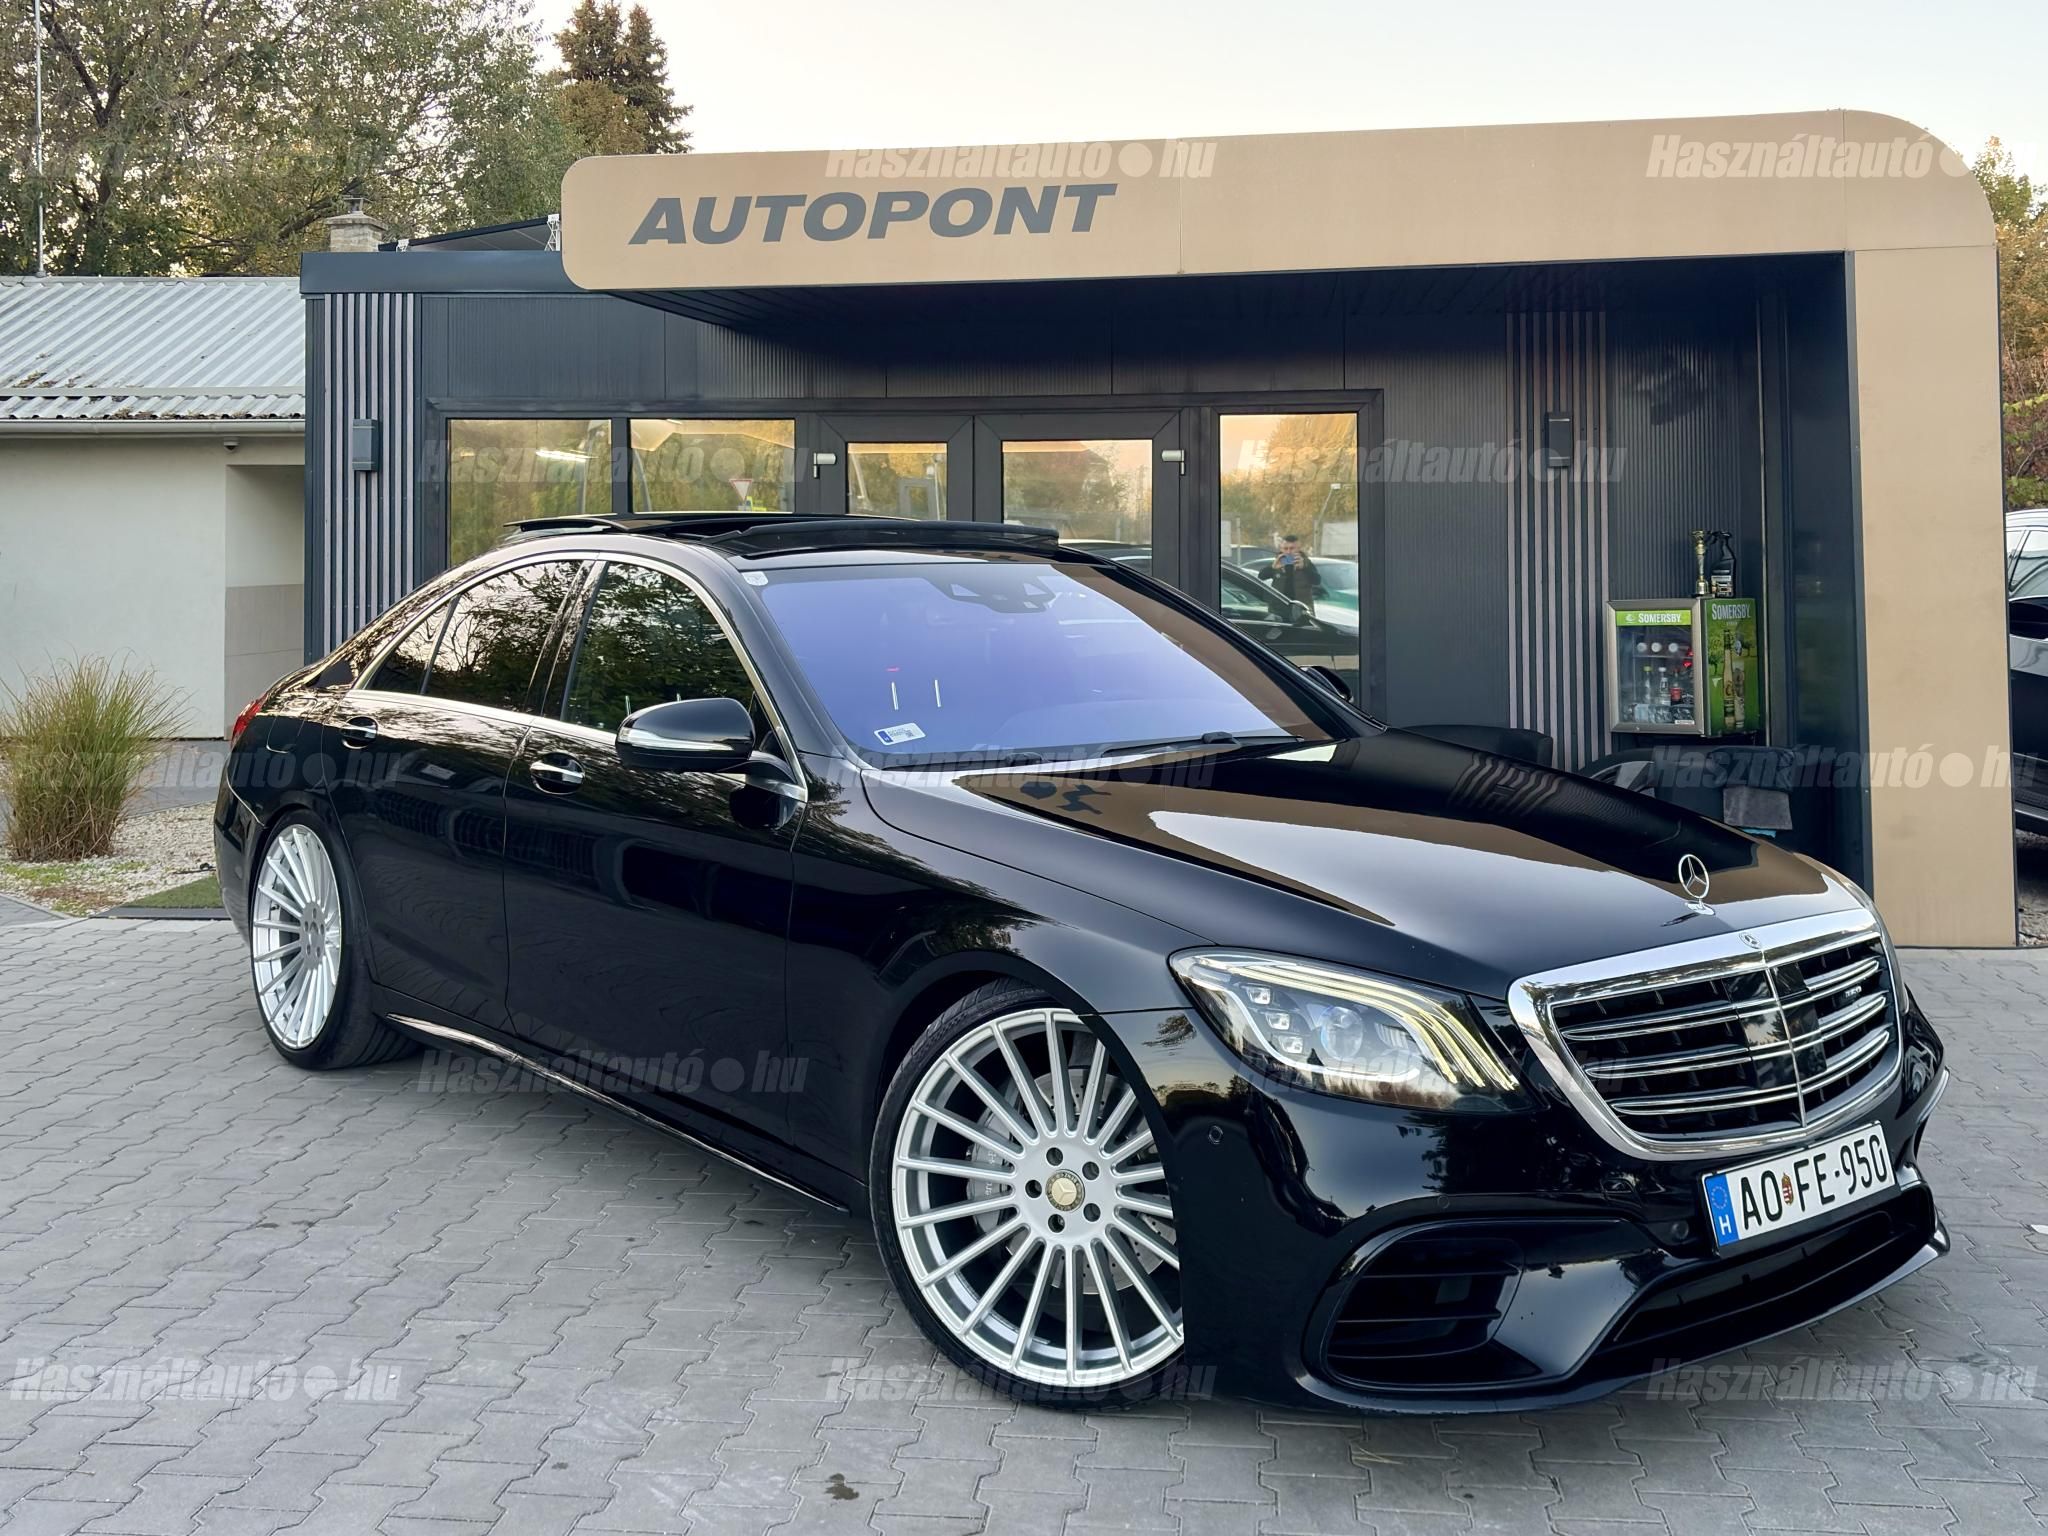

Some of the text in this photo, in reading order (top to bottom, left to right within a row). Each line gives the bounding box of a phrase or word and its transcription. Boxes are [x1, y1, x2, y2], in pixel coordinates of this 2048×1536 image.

[628, 183, 1118, 245] AUTOPONT
[1638, 613, 1681, 623] SOMERSBY
[1711, 603, 1751, 620] SOMERSBY
